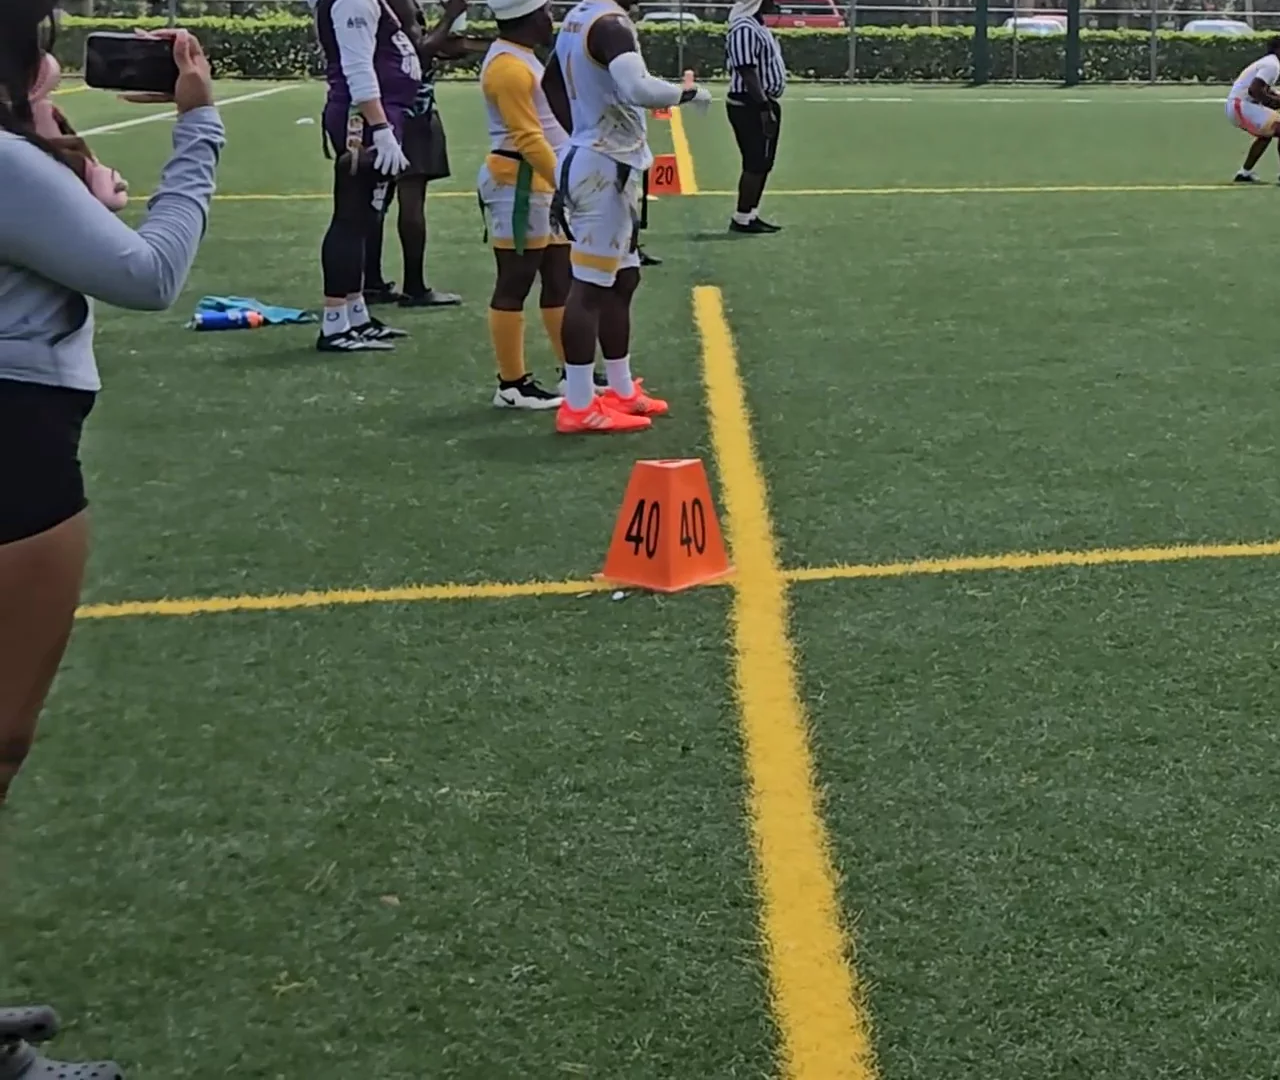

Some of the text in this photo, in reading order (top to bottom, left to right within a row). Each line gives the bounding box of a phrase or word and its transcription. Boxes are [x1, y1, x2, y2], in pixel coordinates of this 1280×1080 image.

[655, 164, 674, 185] 20
[624, 498, 661, 560] 40
[679, 497, 706, 558] 40
